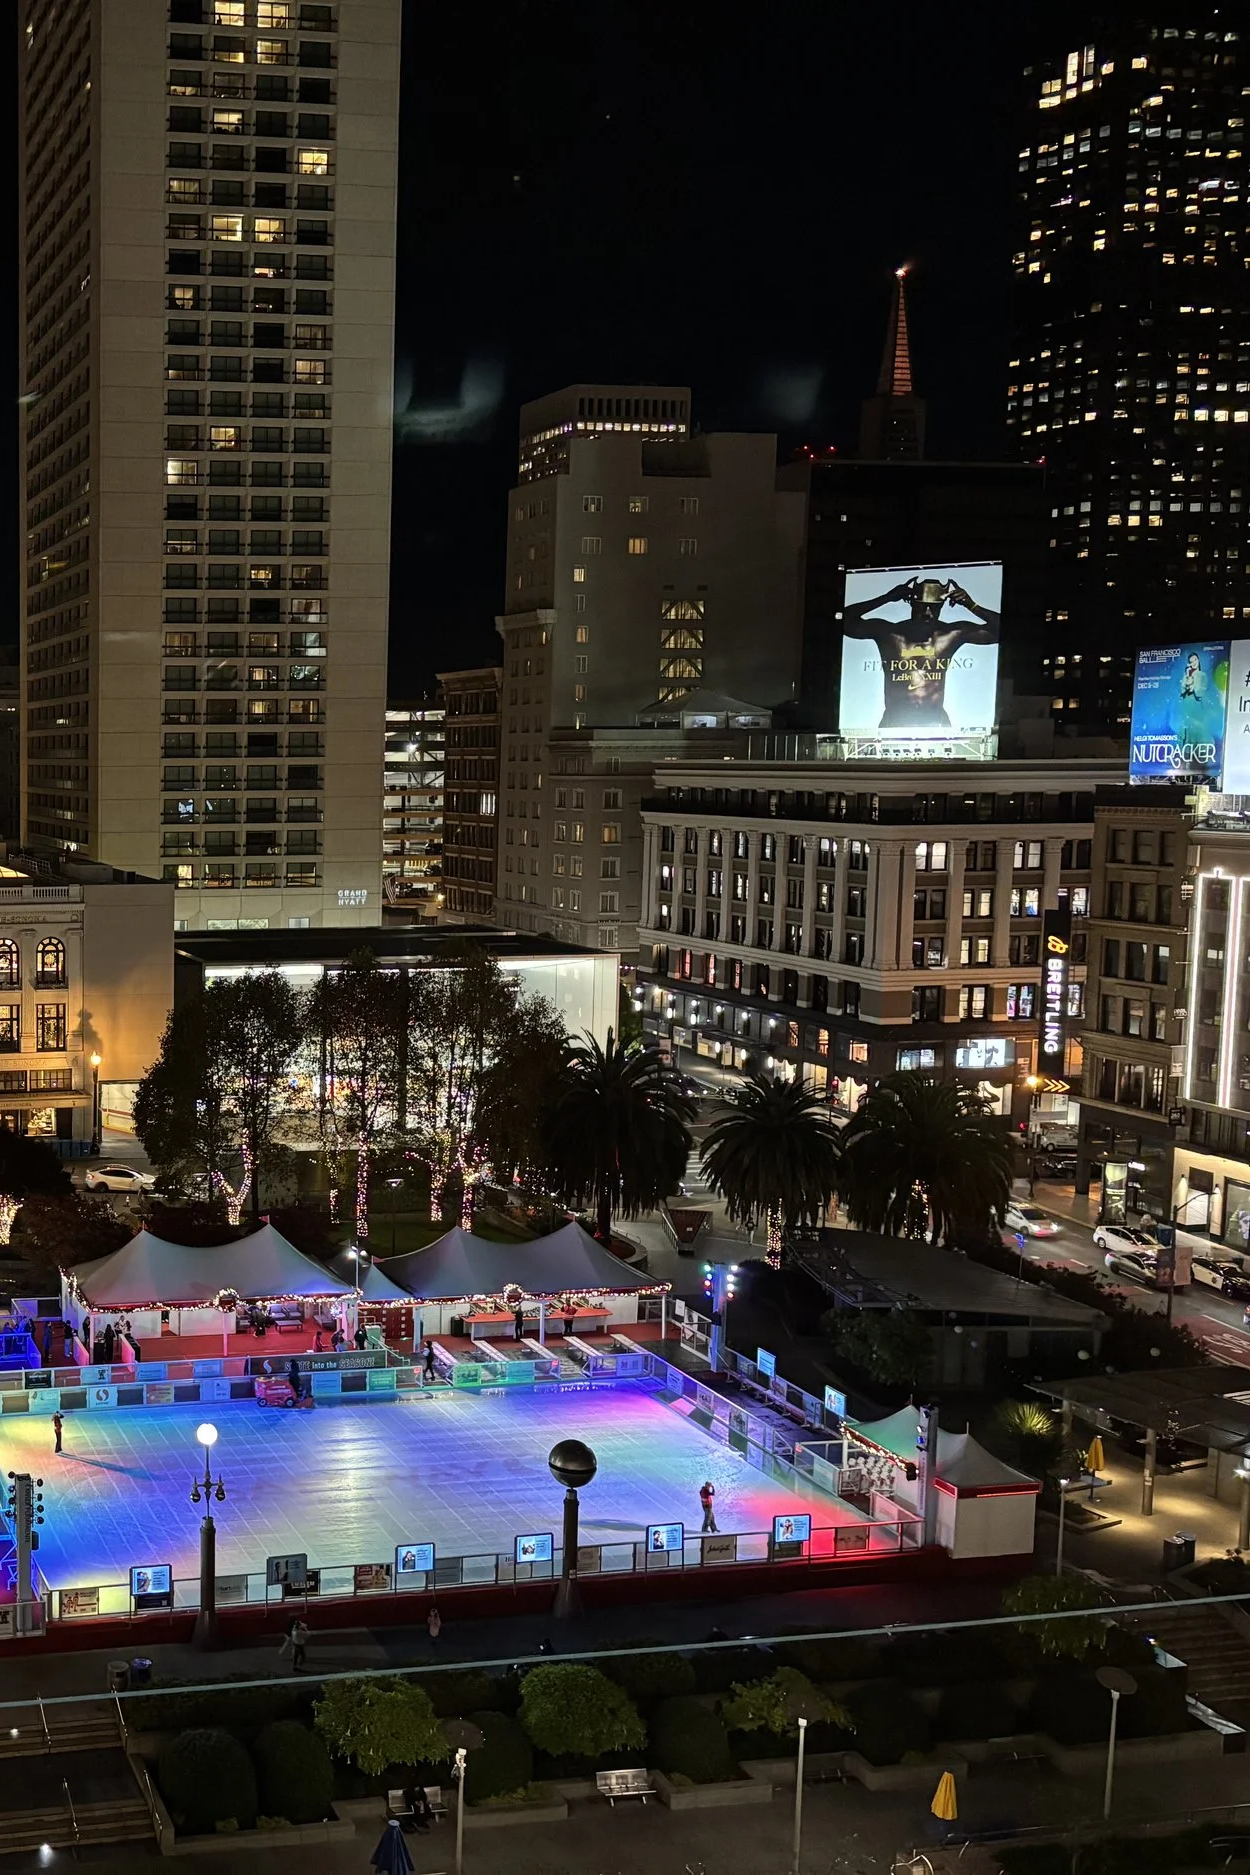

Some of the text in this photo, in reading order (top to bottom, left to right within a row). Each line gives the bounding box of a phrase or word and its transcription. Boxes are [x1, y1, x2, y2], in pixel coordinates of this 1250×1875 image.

[1139, 648, 1181, 658] SAN FRANCISCO
[863, 657, 973, 671] FIT FOR A KING
[1132, 743, 1217, 768] NUTCRACKER
[337, 889, 368, 897] GRAND
[338, 898, 367, 906] HYATT
[1043, 958, 1063, 1053] BREITLING
[326, 1360, 337, 1369] the
[338, 1357, 374, 1369] SEASON!
